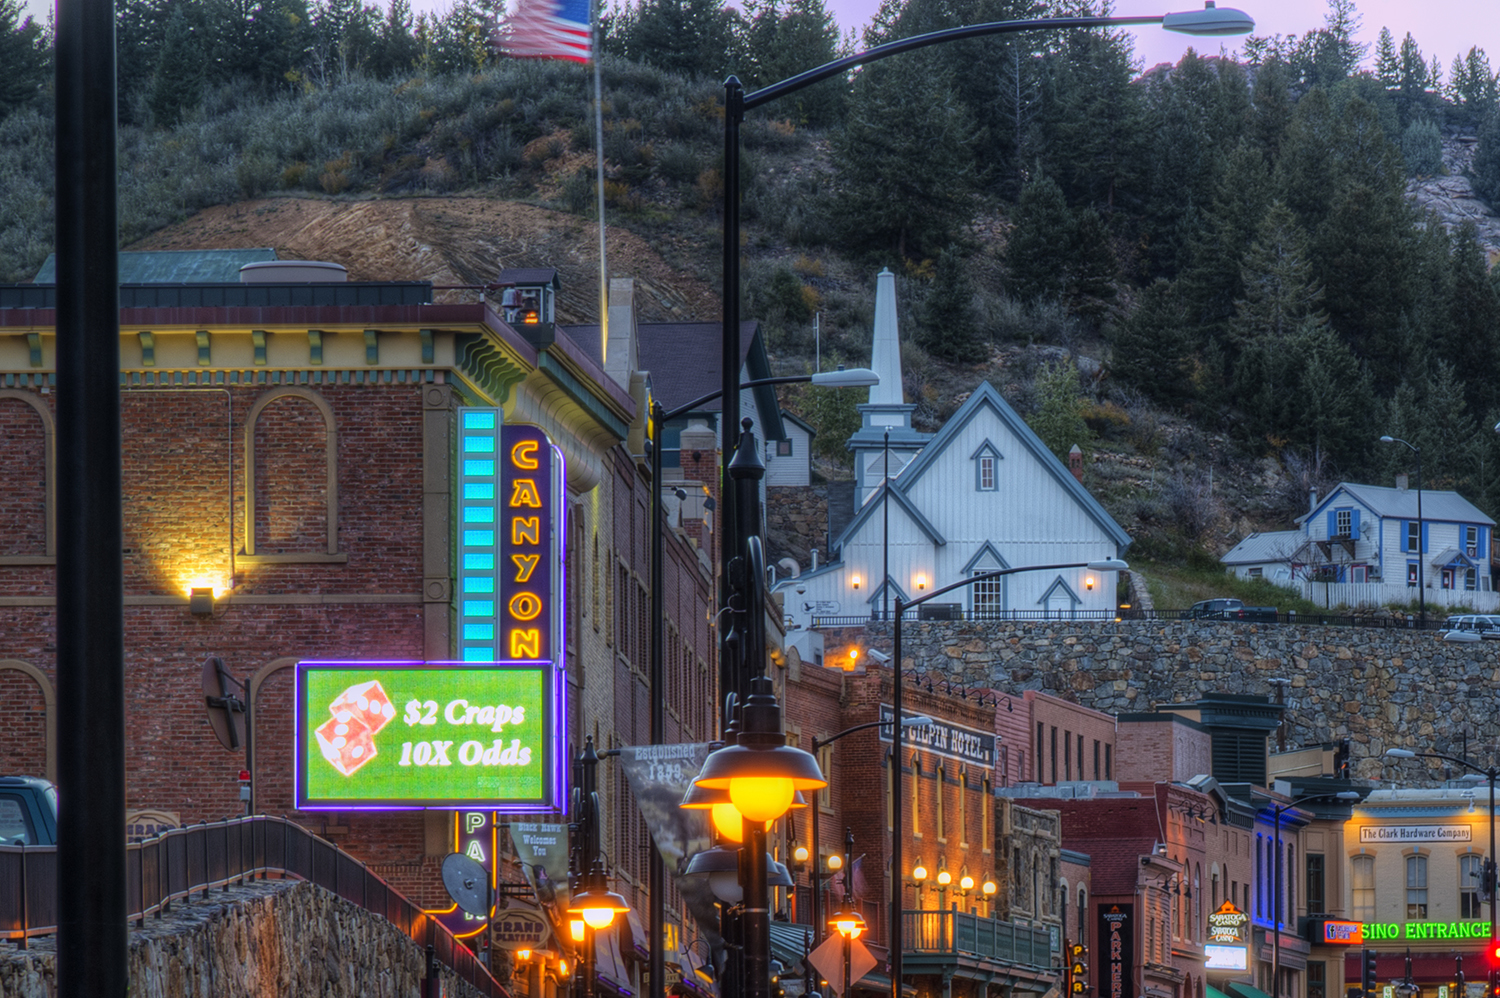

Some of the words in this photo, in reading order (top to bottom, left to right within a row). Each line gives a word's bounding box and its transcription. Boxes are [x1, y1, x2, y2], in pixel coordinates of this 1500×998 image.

[509, 440, 542, 659] CANYON
[403, 699, 438, 726] $2
[444, 699, 525, 732] Craps
[909, 724, 948, 749] GILPIN
[398, 740, 453, 766] 10X
[458, 739, 531, 766] Odds
[635, 745, 695, 760] Established
[523, 835, 556, 845] Welcomes
[1363, 828, 1376, 839] The
[1378, 828, 1398, 838] Clark
[1400, 828, 1435, 838] Hardware
[1437, 827, 1469, 839] Company
[533, 846, 546, 856] You
[493, 921, 544, 933] GRAND
[1405, 921, 1492, 939] ENTRANCE
[496, 933, 540, 941] PLATEAU
[1110, 922, 1122, 960] PARK
